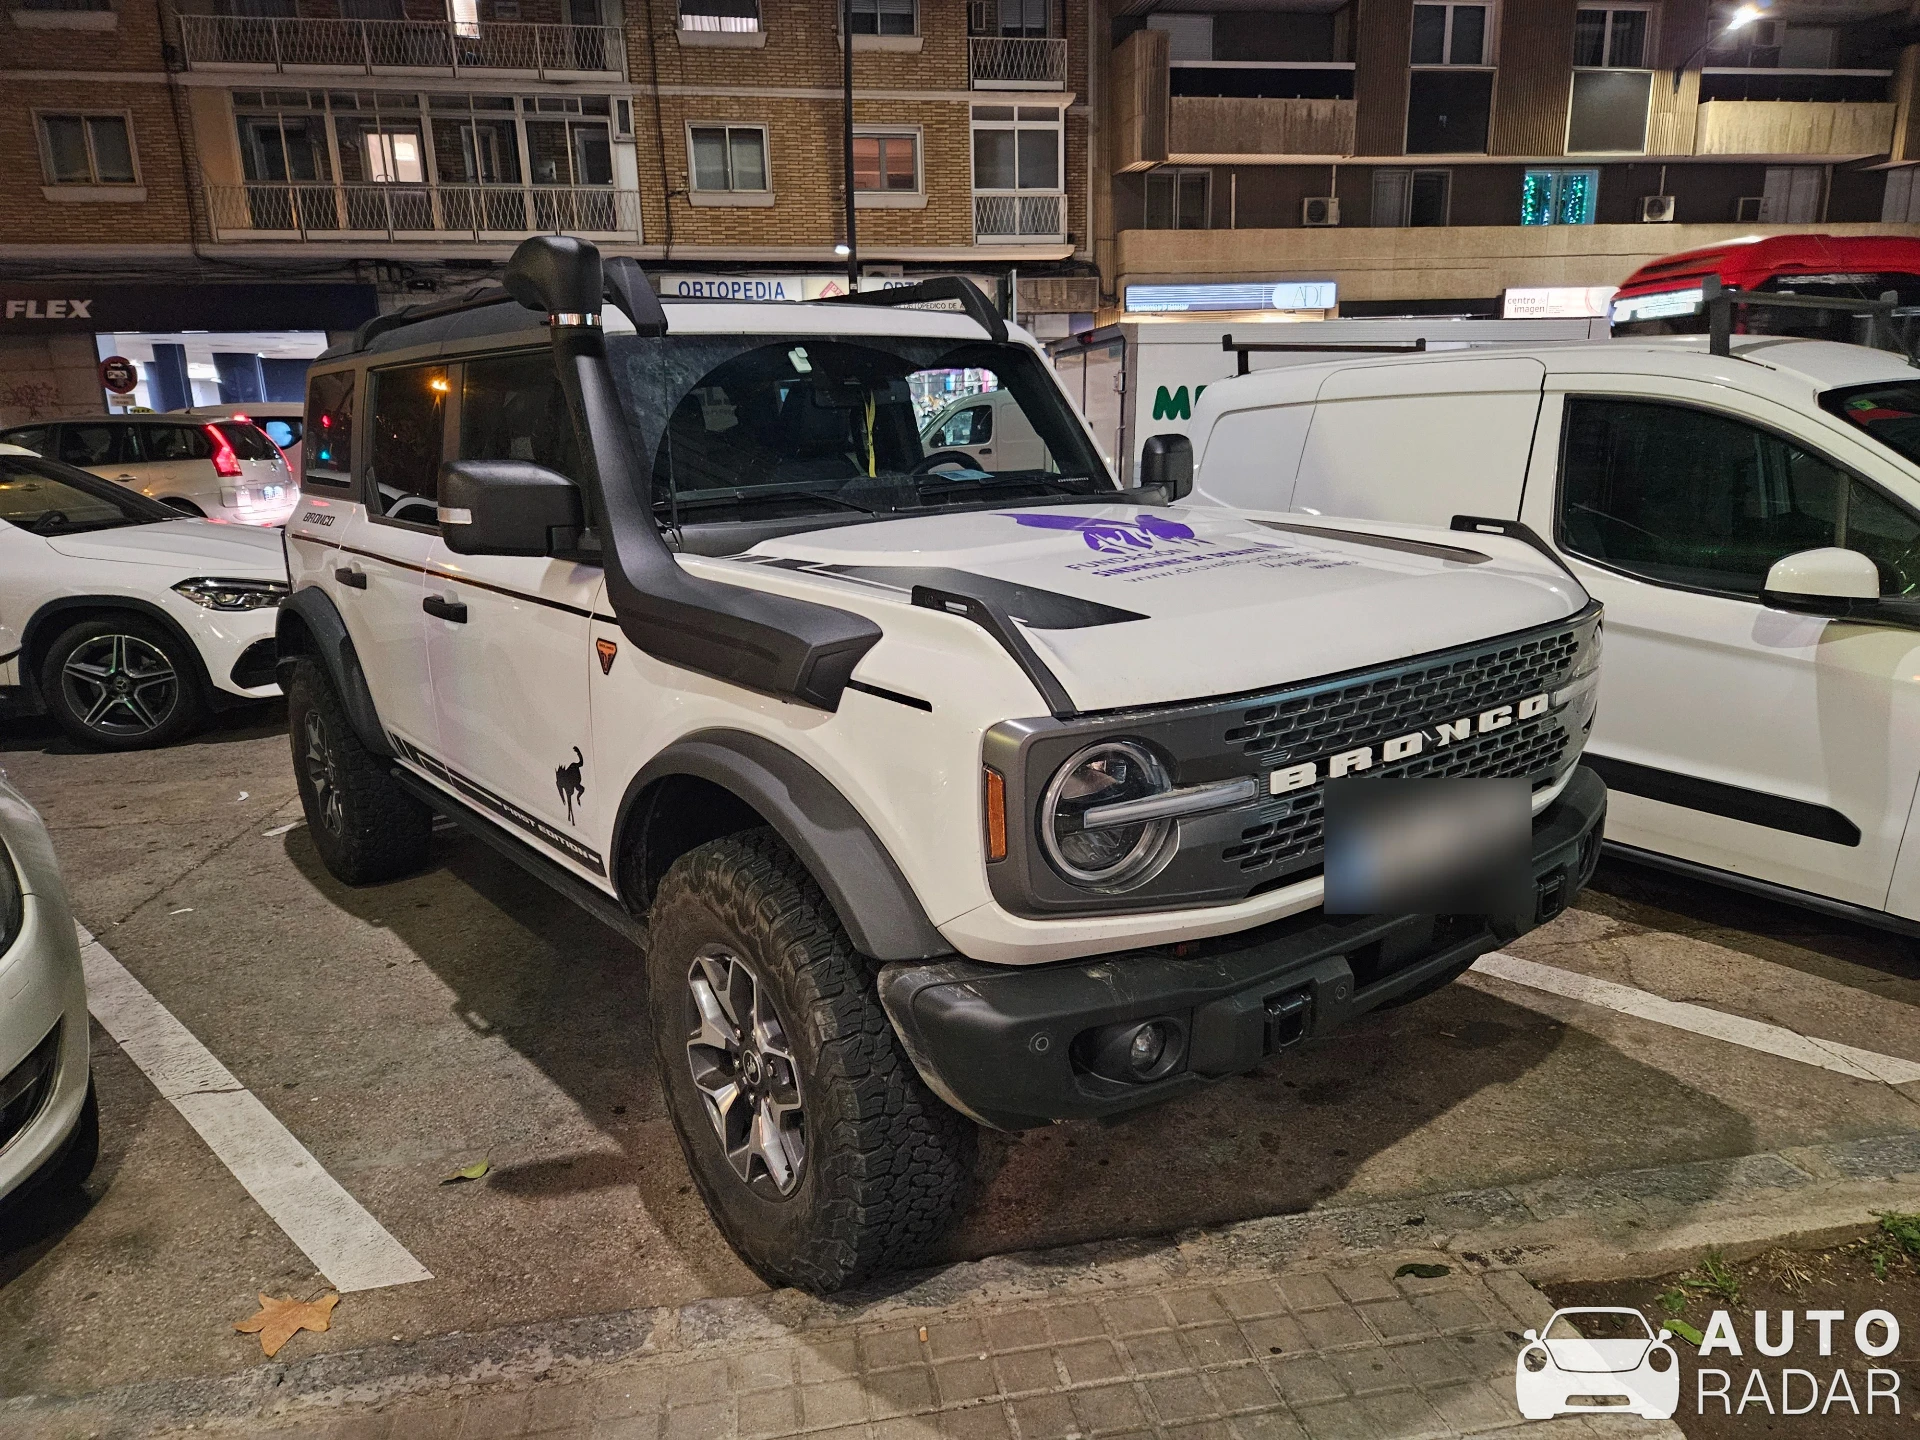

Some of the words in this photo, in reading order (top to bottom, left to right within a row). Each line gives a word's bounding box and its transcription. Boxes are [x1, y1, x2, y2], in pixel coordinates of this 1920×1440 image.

[678, 281, 785, 299] ORTOPEDIA
[1291, 286, 1324, 307] ADI
[5, 299, 93, 319] FLEX
[1514, 305, 1545, 315] imagen
[303, 511, 336, 527] BRONCO
[1064, 548, 1192, 571] FUNDACIÓN
[1270, 693, 1548, 795] BRONCO
[503, 804, 536, 827] FIRST
[538, 824, 589, 859] EDITION
